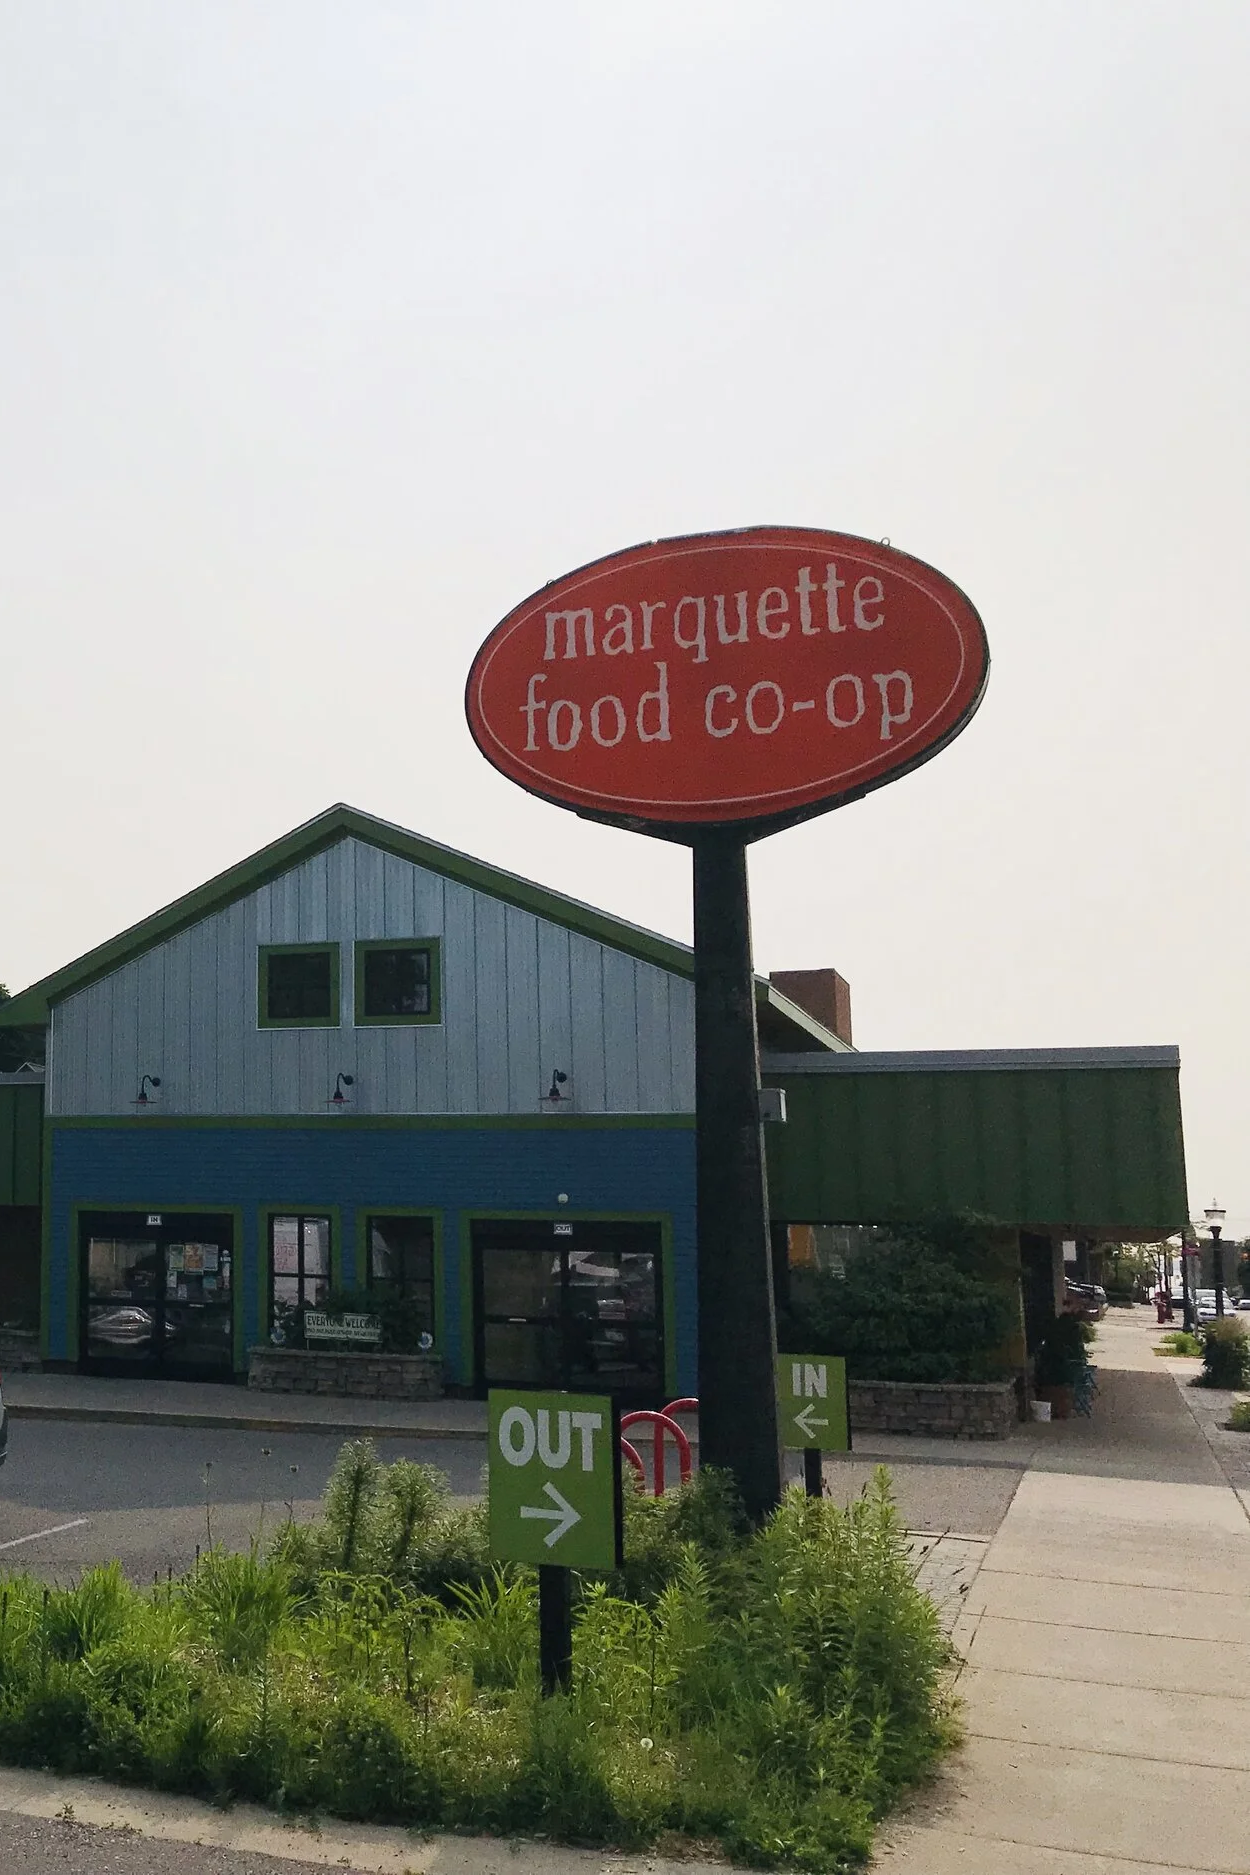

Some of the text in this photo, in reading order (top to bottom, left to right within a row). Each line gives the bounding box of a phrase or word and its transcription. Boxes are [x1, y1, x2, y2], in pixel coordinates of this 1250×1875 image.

[543, 562, 886, 663] marquette
[519, 662, 914, 752] food co-op
[307, 1315, 344, 1328] EVERYO
[792, 1363, 827, 1398] IN
[499, 1406, 603, 1472] OUT
